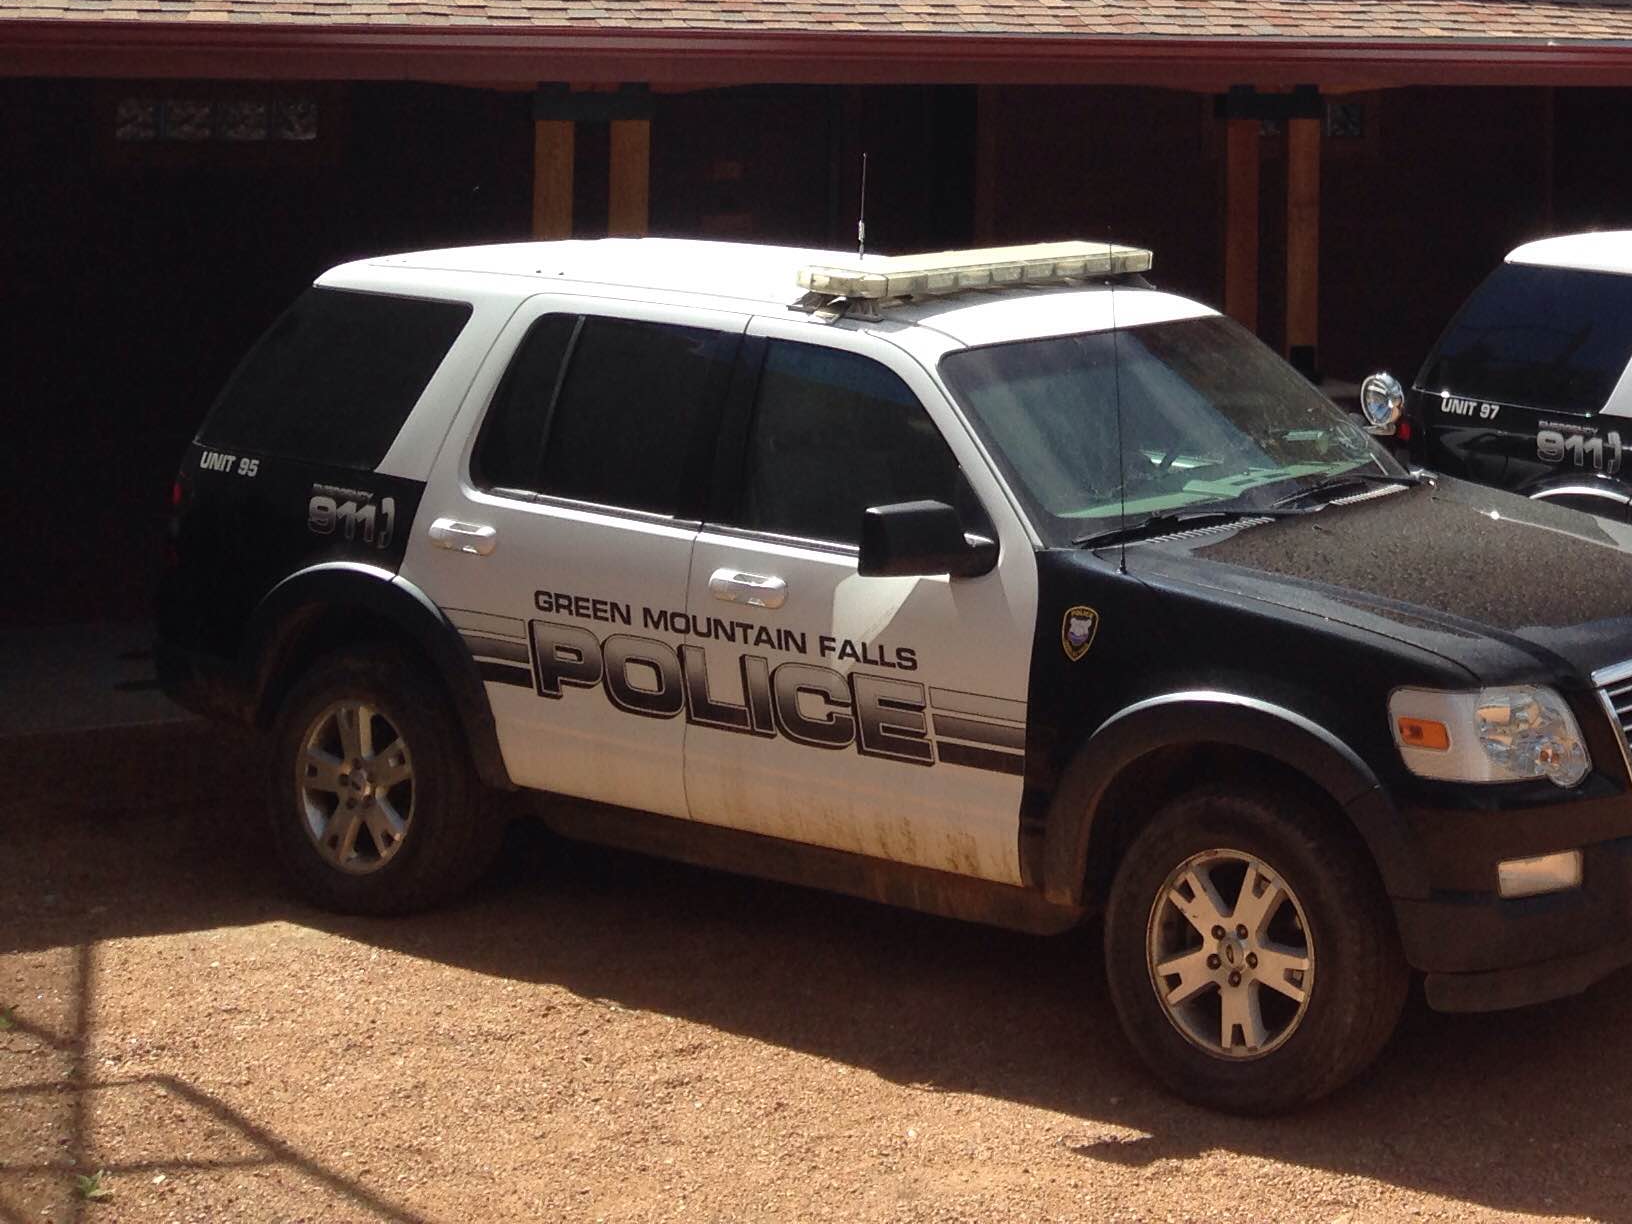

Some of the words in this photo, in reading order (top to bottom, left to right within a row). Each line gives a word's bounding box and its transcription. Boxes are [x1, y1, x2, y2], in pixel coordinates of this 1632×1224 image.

[1441, 398, 1477, 416] UNIT
[1480, 403, 1500, 419] 97
[200, 451, 236, 472] UNIT
[238, 458, 260, 477] 95
[1537, 431, 1603, 469] 911
[308, 496, 376, 543] 911
[534, 590, 632, 626] GREEN
[643, 607, 807, 654] MOUNTAIN
[819, 635, 918, 671] FALLS
[528, 618, 936, 767] POLICE
